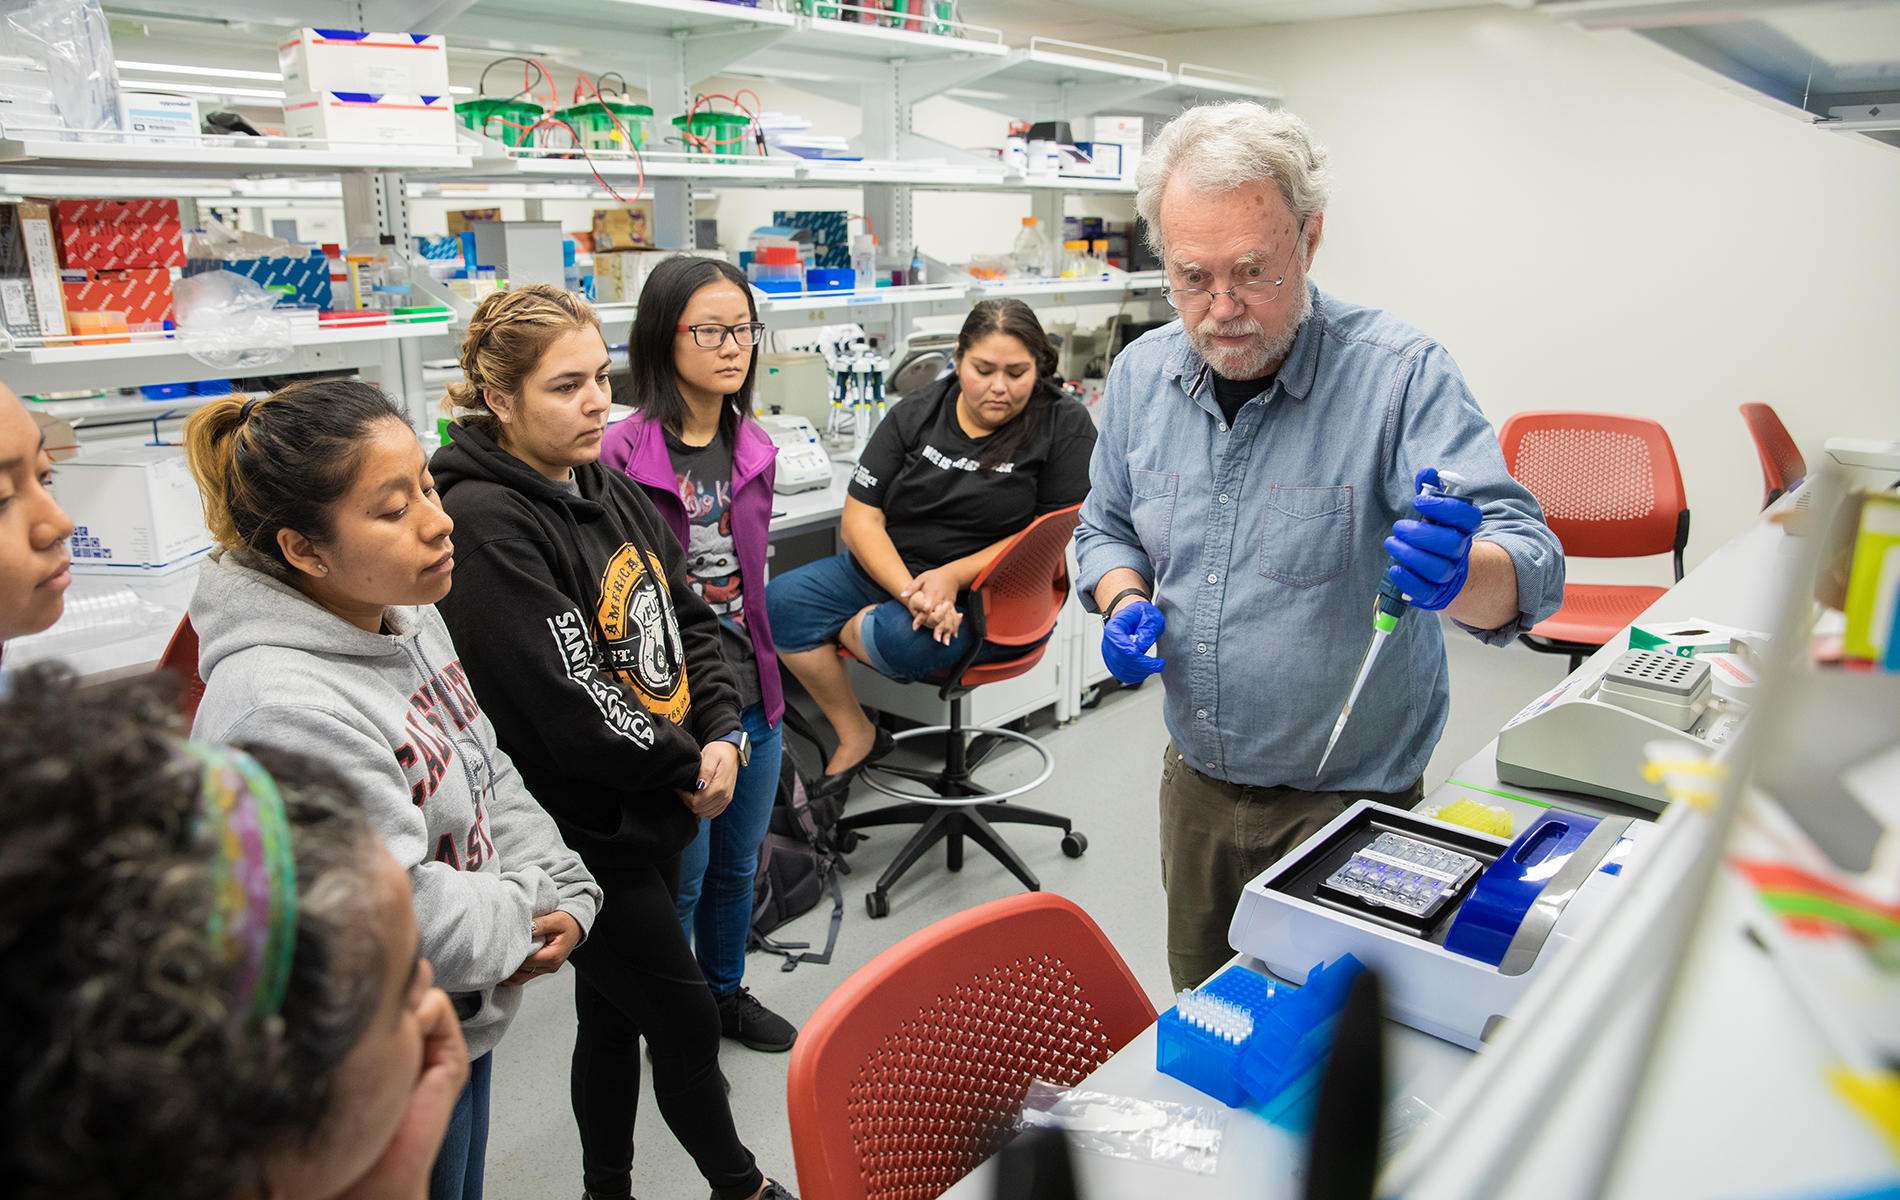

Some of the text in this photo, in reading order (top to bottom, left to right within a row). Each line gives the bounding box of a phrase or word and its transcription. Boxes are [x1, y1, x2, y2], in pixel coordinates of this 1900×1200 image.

[555, 611, 593, 681] SANTA
[394, 659, 480, 807] CAL STAT
[591, 682, 655, 746] MONICA
